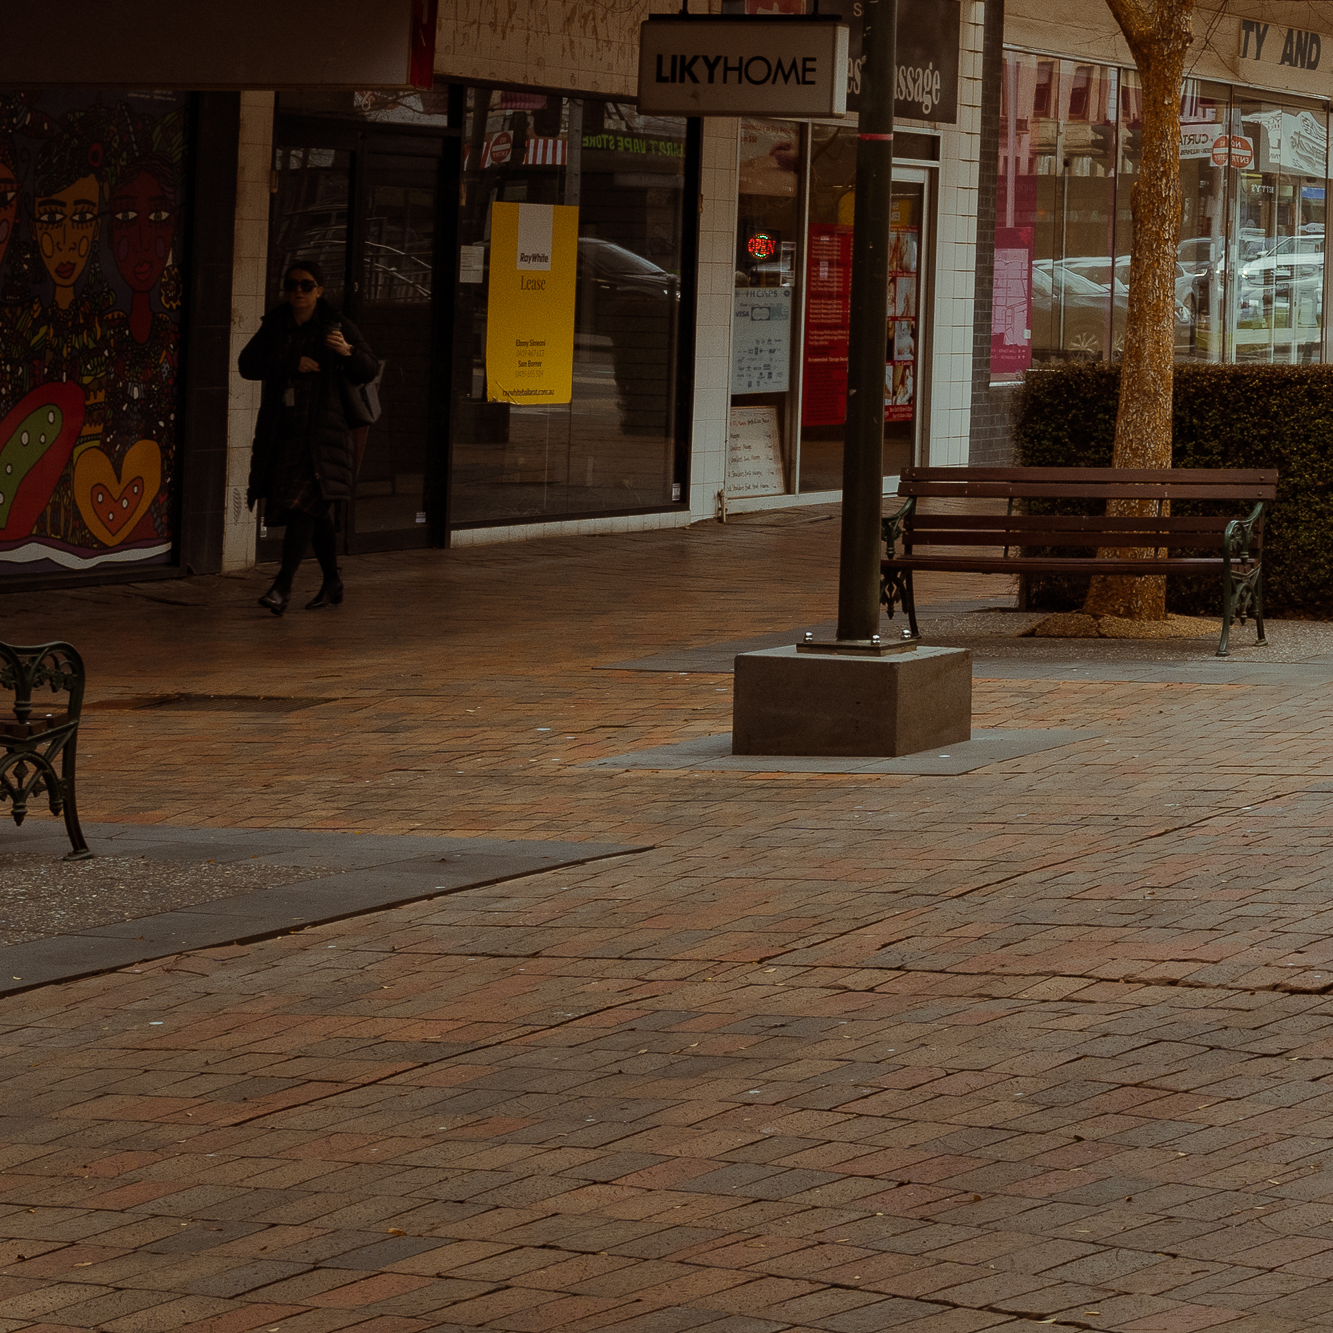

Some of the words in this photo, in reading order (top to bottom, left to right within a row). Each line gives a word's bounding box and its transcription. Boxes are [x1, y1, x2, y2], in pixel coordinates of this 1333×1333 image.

[1278, 28, 1322, 71] AND
[656, 54, 817, 86] LIKYHOME
[894, 62, 941, 115] ssage
[747, 238, 776, 256] OPEN
[520, 275, 546, 291] Lease
[736, 310, 750, 318] VISA
